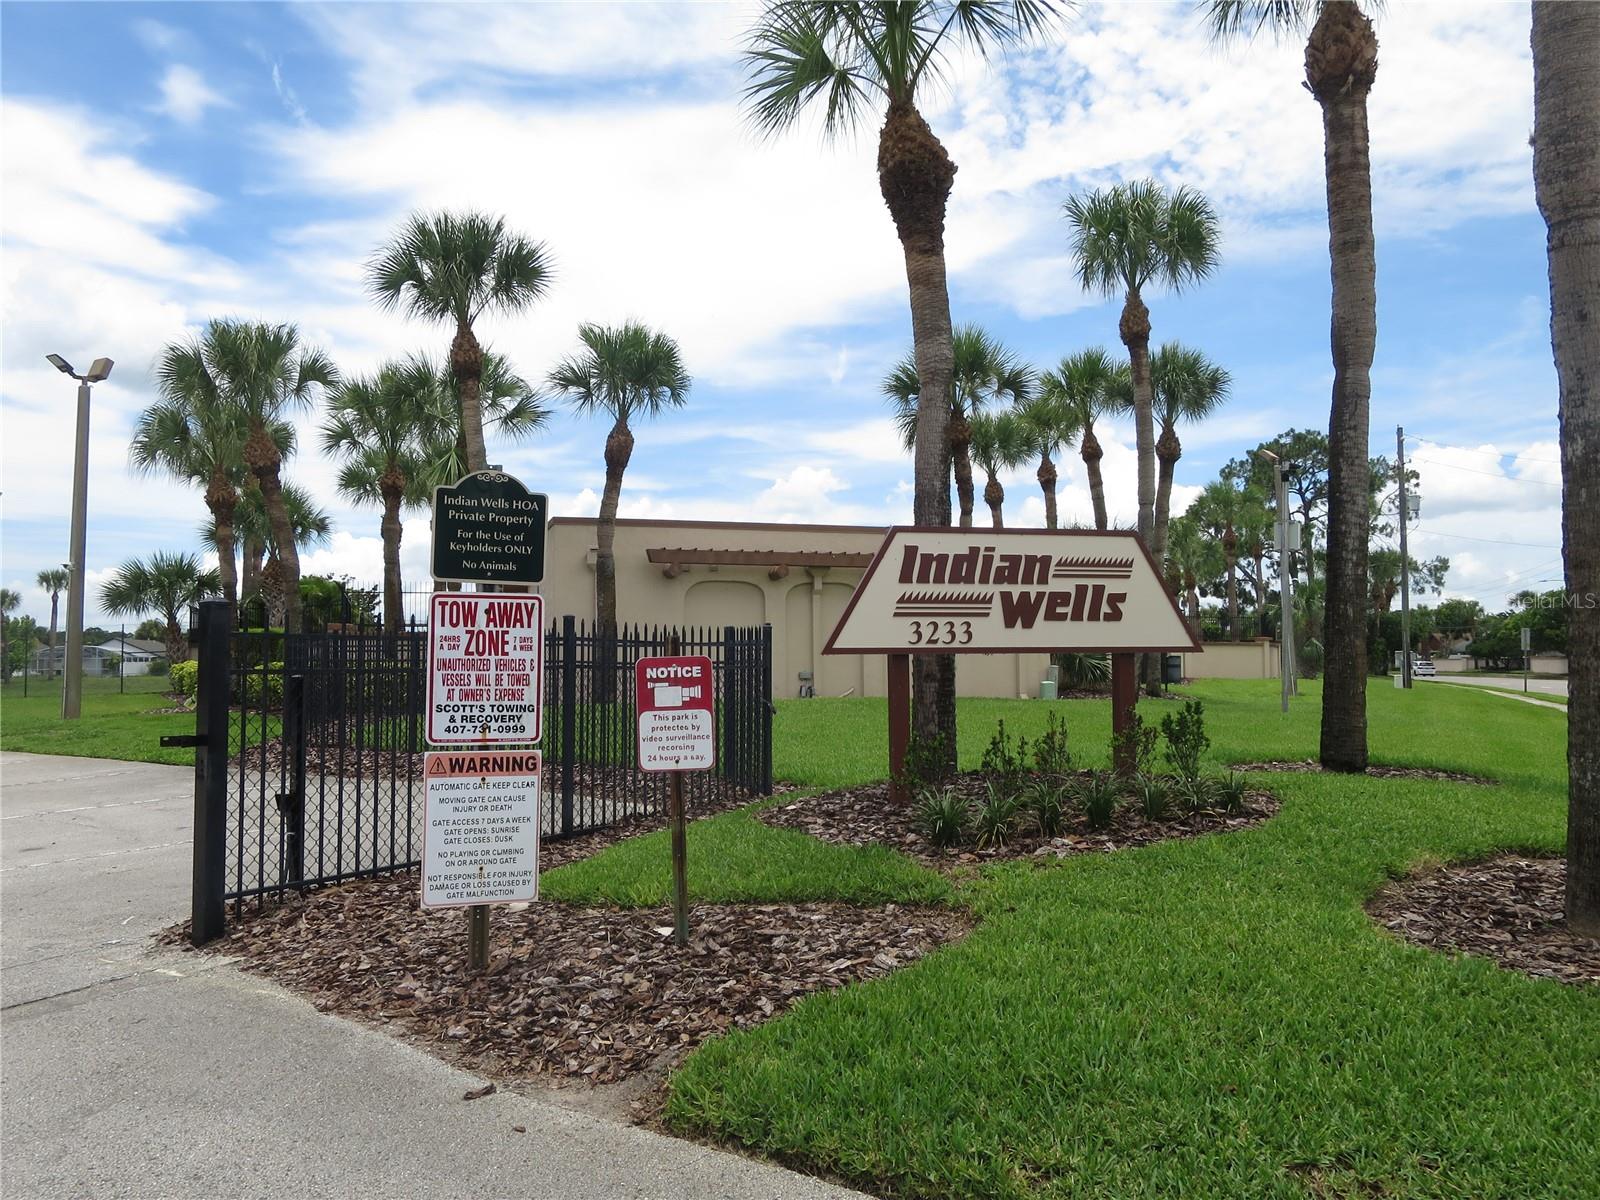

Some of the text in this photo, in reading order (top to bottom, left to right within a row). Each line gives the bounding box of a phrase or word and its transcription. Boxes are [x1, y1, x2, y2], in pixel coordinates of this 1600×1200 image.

[444, 496, 539, 511] Indian Wells HOA
[448, 510, 533, 527] Private Property
[457, 530, 524, 541] For the Use of
[450, 542, 533, 554] Keyholders ONLY
[462, 560, 516, 570] No Animals
[898, 545, 1053, 585] Indian
[438, 601, 535, 628] TOW AWAY
[908, 621, 973, 645] 3233
[464, 630, 509, 656] ZONE
[437, 658, 535, 672] UNAUTHORIZED VEHICLES &
[647, 666, 701, 678] NOTICE
[442, 674, 530, 686] VESSELS WILL BE TOWED
[447, 689, 524, 702] AT OWNER'S EXPENSE
[435, 704, 535, 713] SCOTT'S TOWING
[449, 715, 523, 723] & RECOVERY
[672, 714, 689, 722] park
[692, 723, 700, 731] by
[666, 733, 710, 741] surveillance
[449, 756, 537, 773] WARNING
[430, 783, 470, 791] AUTOMATIC
[469, 858, 497, 866] AROUND
[444, 873, 491, 881] RESPONSIBLE
[430, 883, 459, 891] DAMAGE
[466, 889, 514, 897] MALFUNCTION
